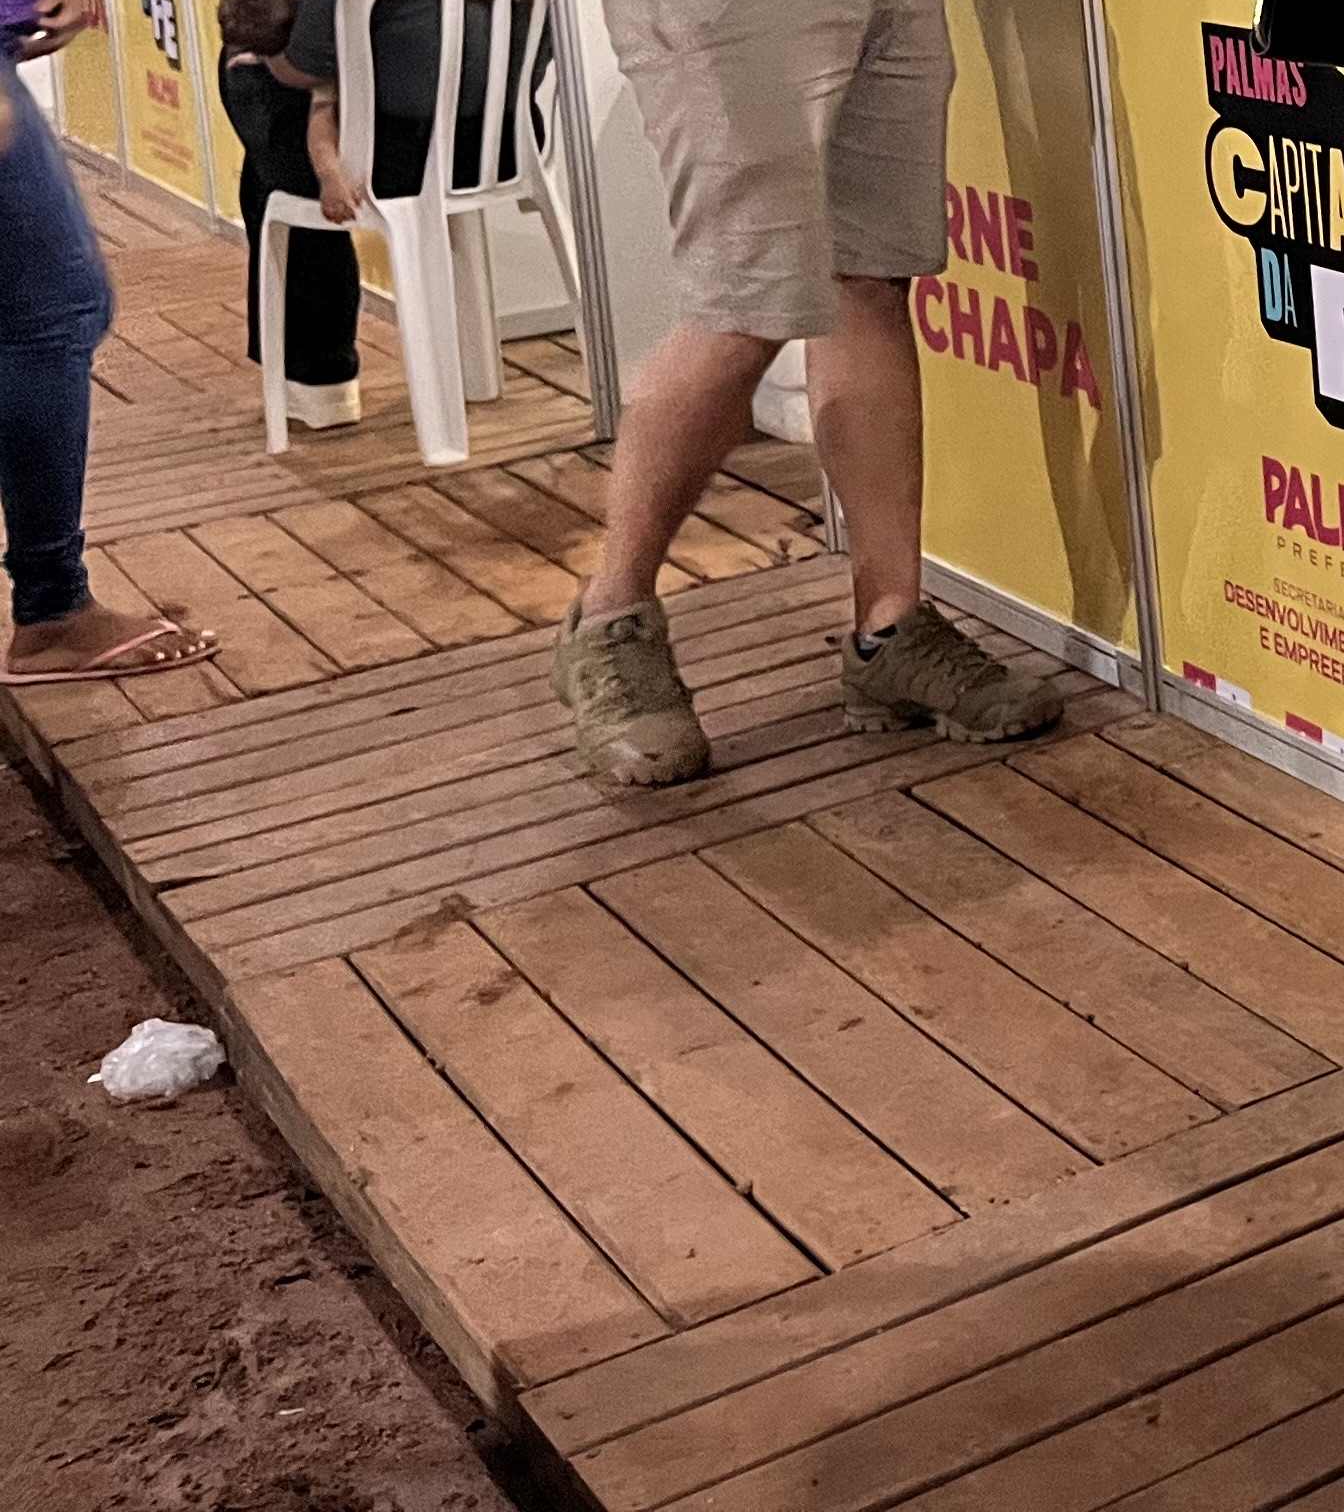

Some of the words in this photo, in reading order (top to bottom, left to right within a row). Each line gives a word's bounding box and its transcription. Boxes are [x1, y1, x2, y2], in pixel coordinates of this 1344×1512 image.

[1209, 35, 1307, 107] PALMAS
[947, 181, 1039, 281] RNE
[1261, 247, 1298, 328] DA
[915, 275, 1103, 412] CHAPA
[1260, 626, 1271, 650] E
